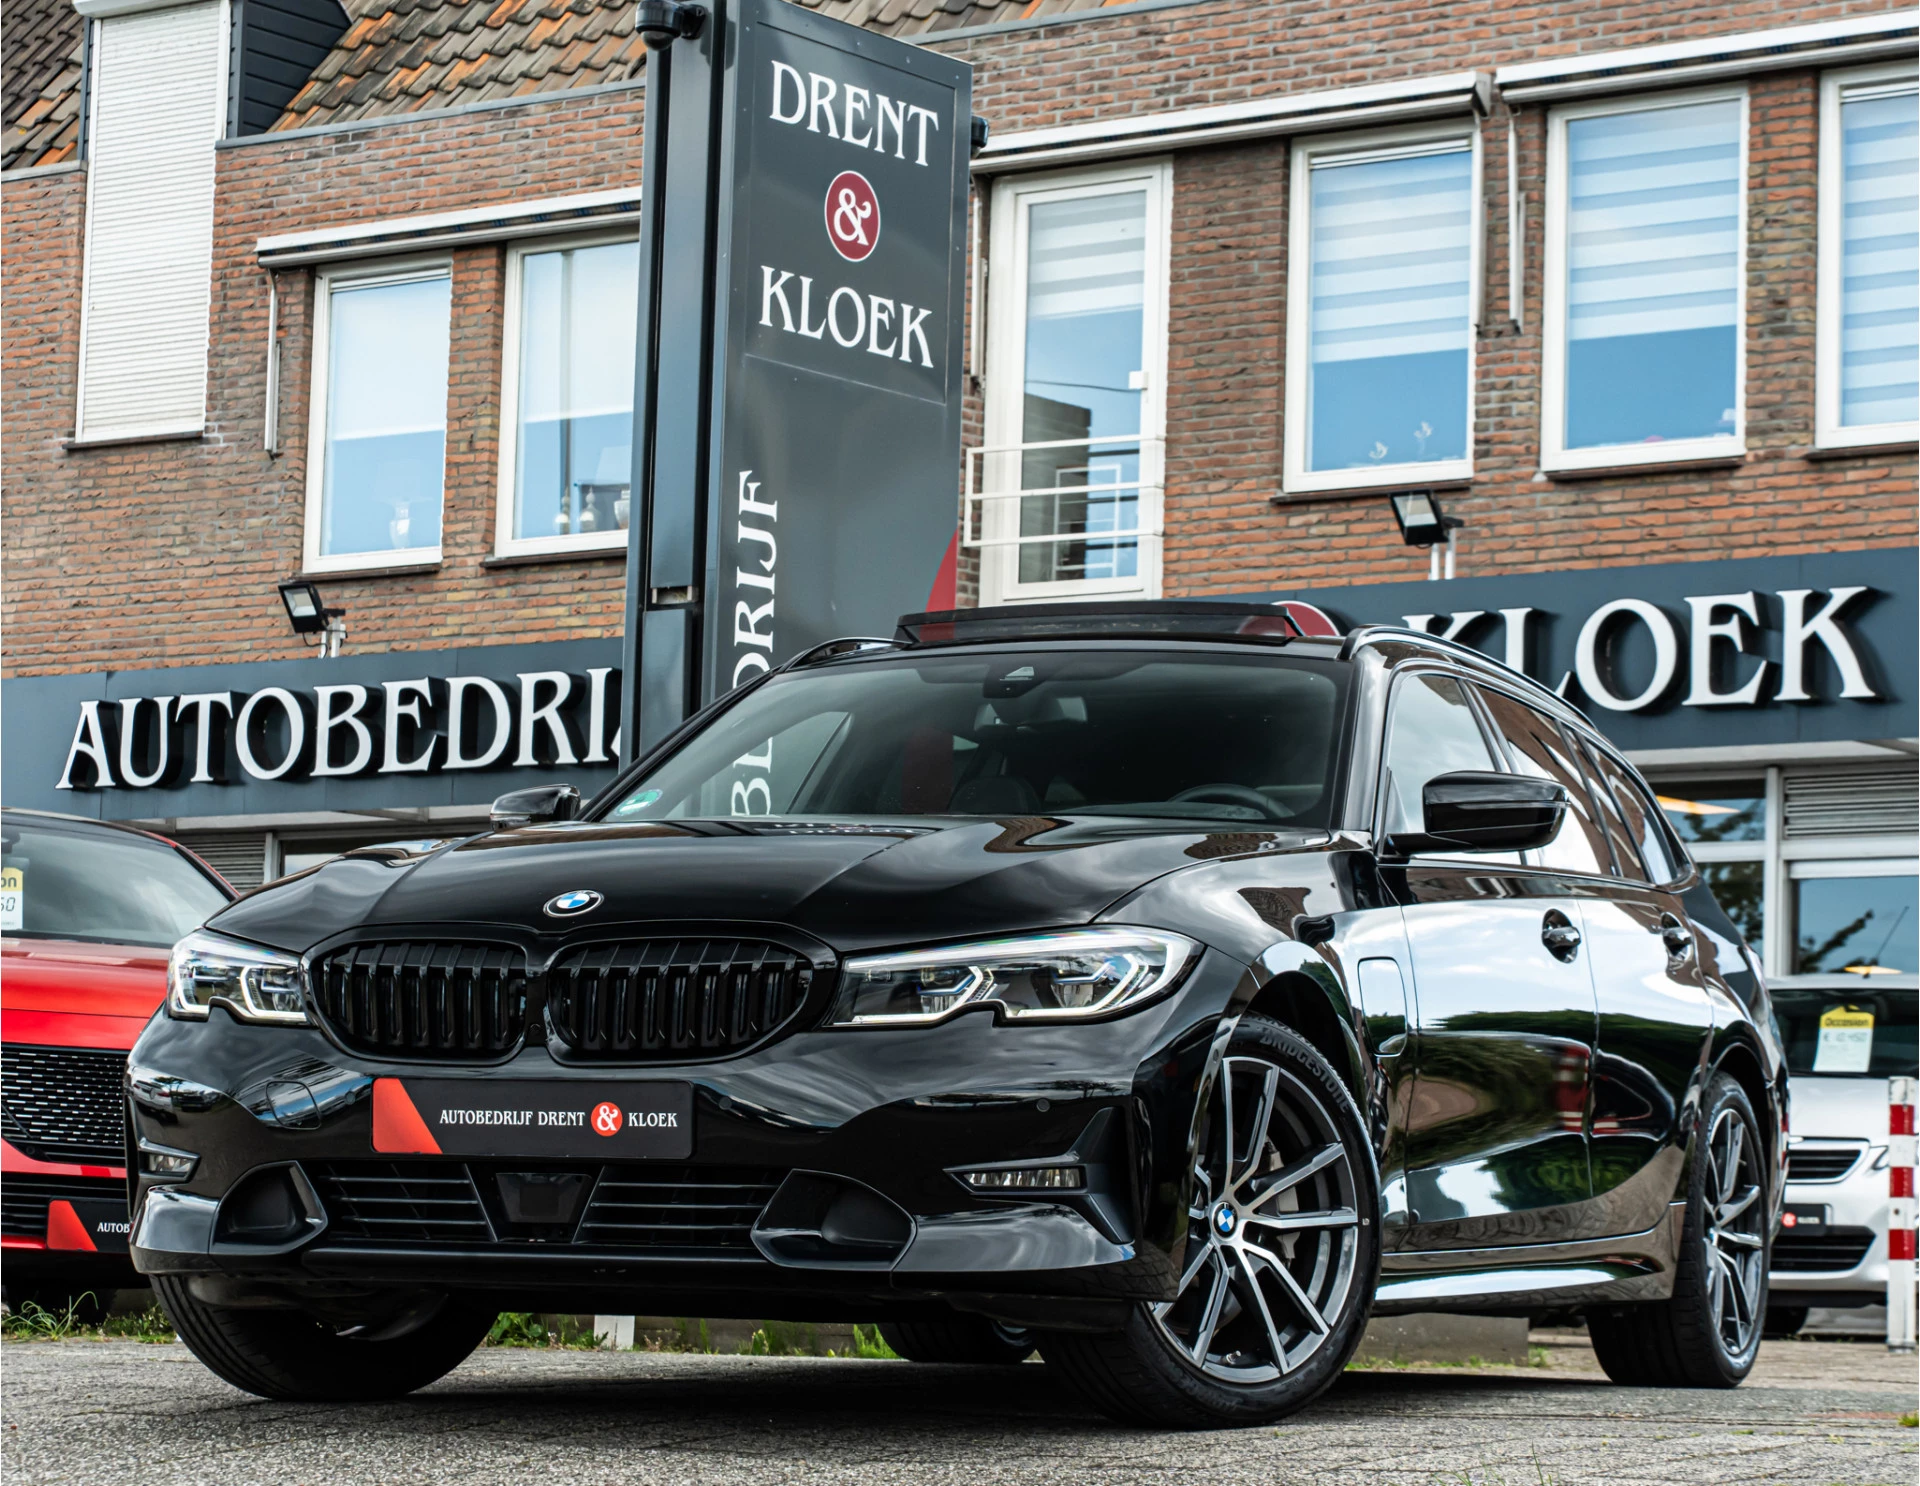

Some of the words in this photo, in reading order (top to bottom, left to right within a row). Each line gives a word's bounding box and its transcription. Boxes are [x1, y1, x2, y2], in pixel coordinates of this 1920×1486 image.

[769, 60, 939, 167] DRENT
[833, 188, 871, 246] &
[758, 265, 934, 368] KLOEK
[55, 667, 621, 790] AUTOBEDRI
[439, 1109, 534, 1126] AUTOBEDRIJF
[538, 1111, 585, 1127] DRENT
[596, 1105, 619, 1131] &
[628, 1112, 678, 1128] KLOEK
